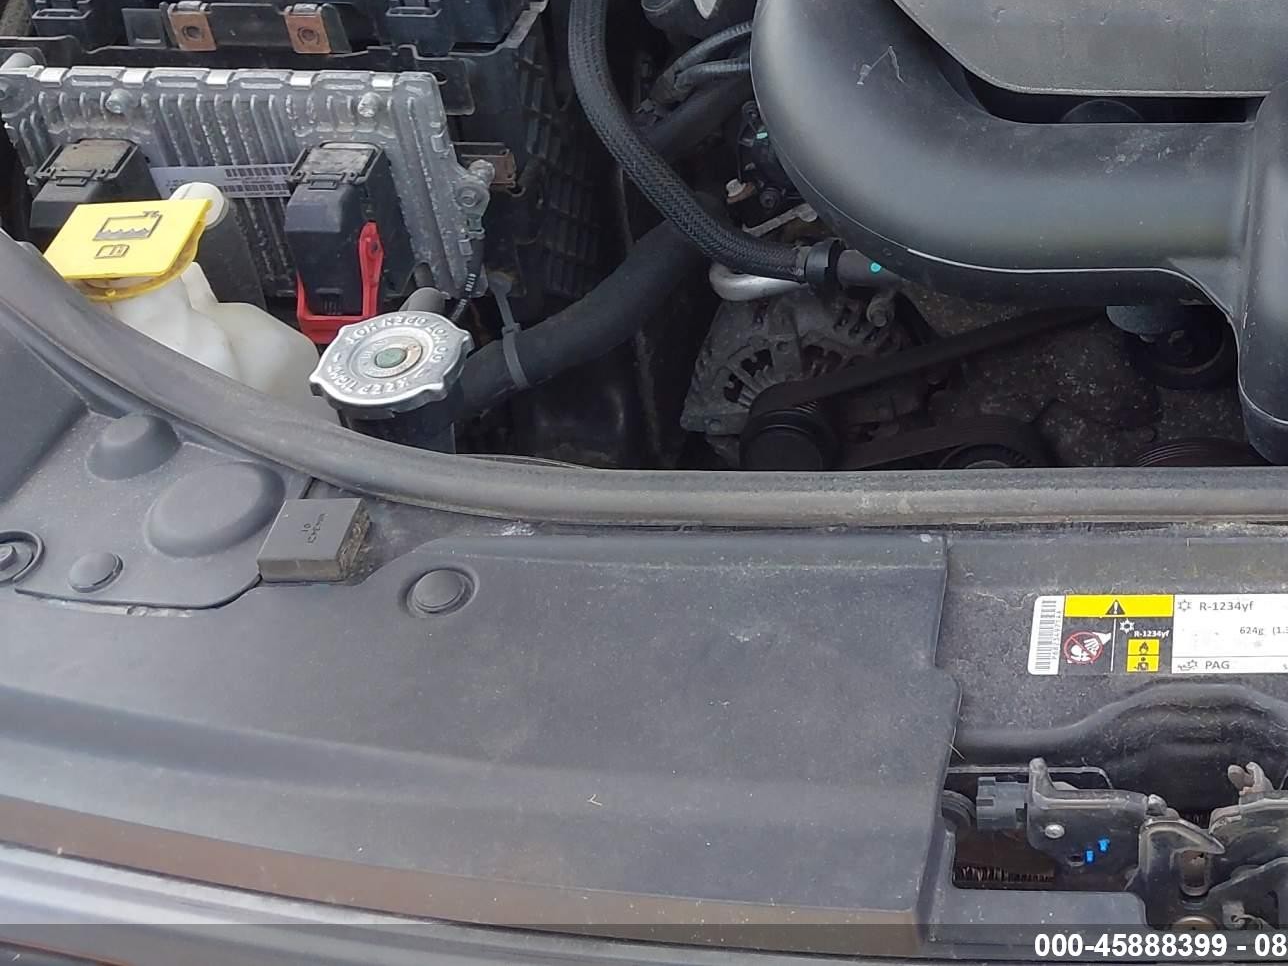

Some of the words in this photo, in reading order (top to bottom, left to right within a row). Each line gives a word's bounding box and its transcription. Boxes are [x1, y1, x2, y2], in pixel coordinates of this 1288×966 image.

[381, 315, 429, 327] OPEN
[344, 322, 378, 345] HOT
[359, 377, 411, 395] KEEP
[1200, 600, 1255, 613] R-1234yf
[1134, 629, 1170, 640] R-1234yf
[1239, 626, 1264, 636] 624g
[1205, 660, 1230, 670] PAG
